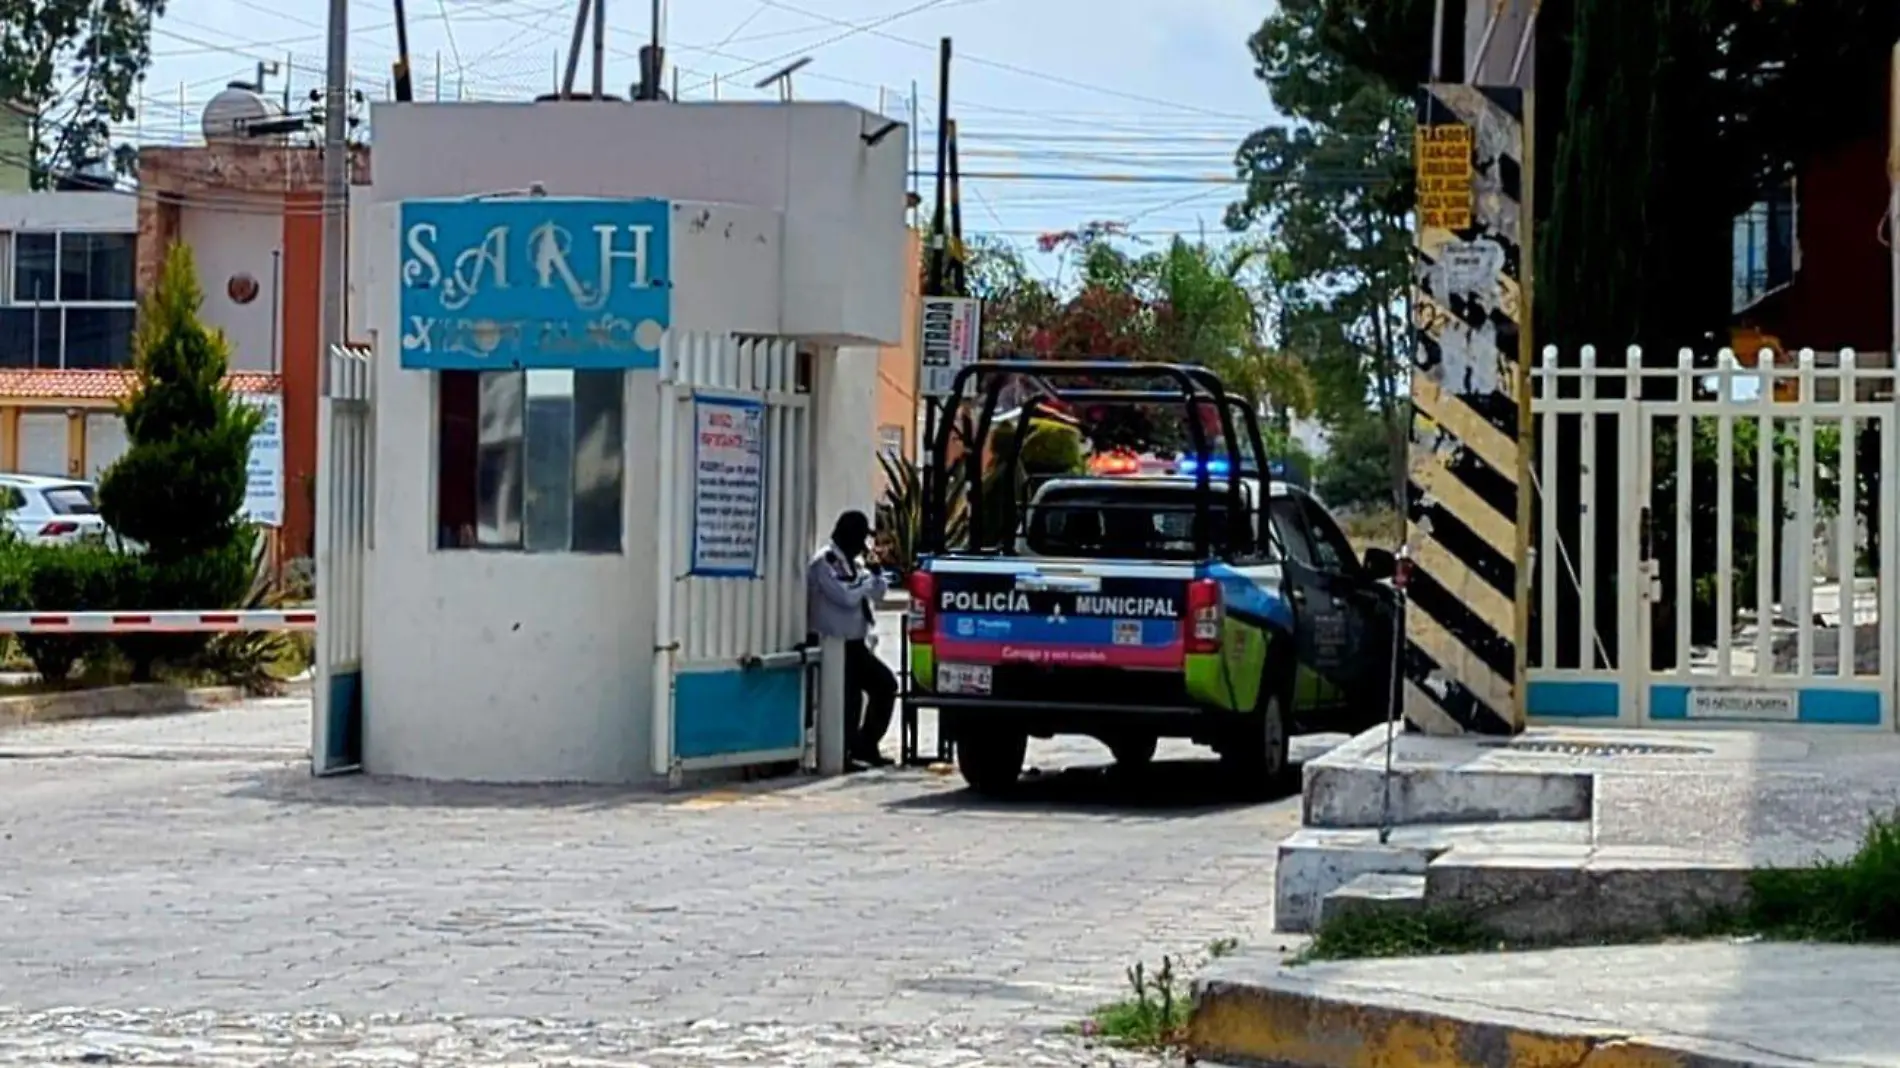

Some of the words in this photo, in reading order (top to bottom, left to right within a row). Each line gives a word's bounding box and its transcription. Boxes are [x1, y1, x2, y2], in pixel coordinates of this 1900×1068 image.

[923, 303, 953, 367] ENTRADA
[941, 591, 1030, 612] POLICÍA
[1076, 596, 1178, 617] MUNICIPAL
